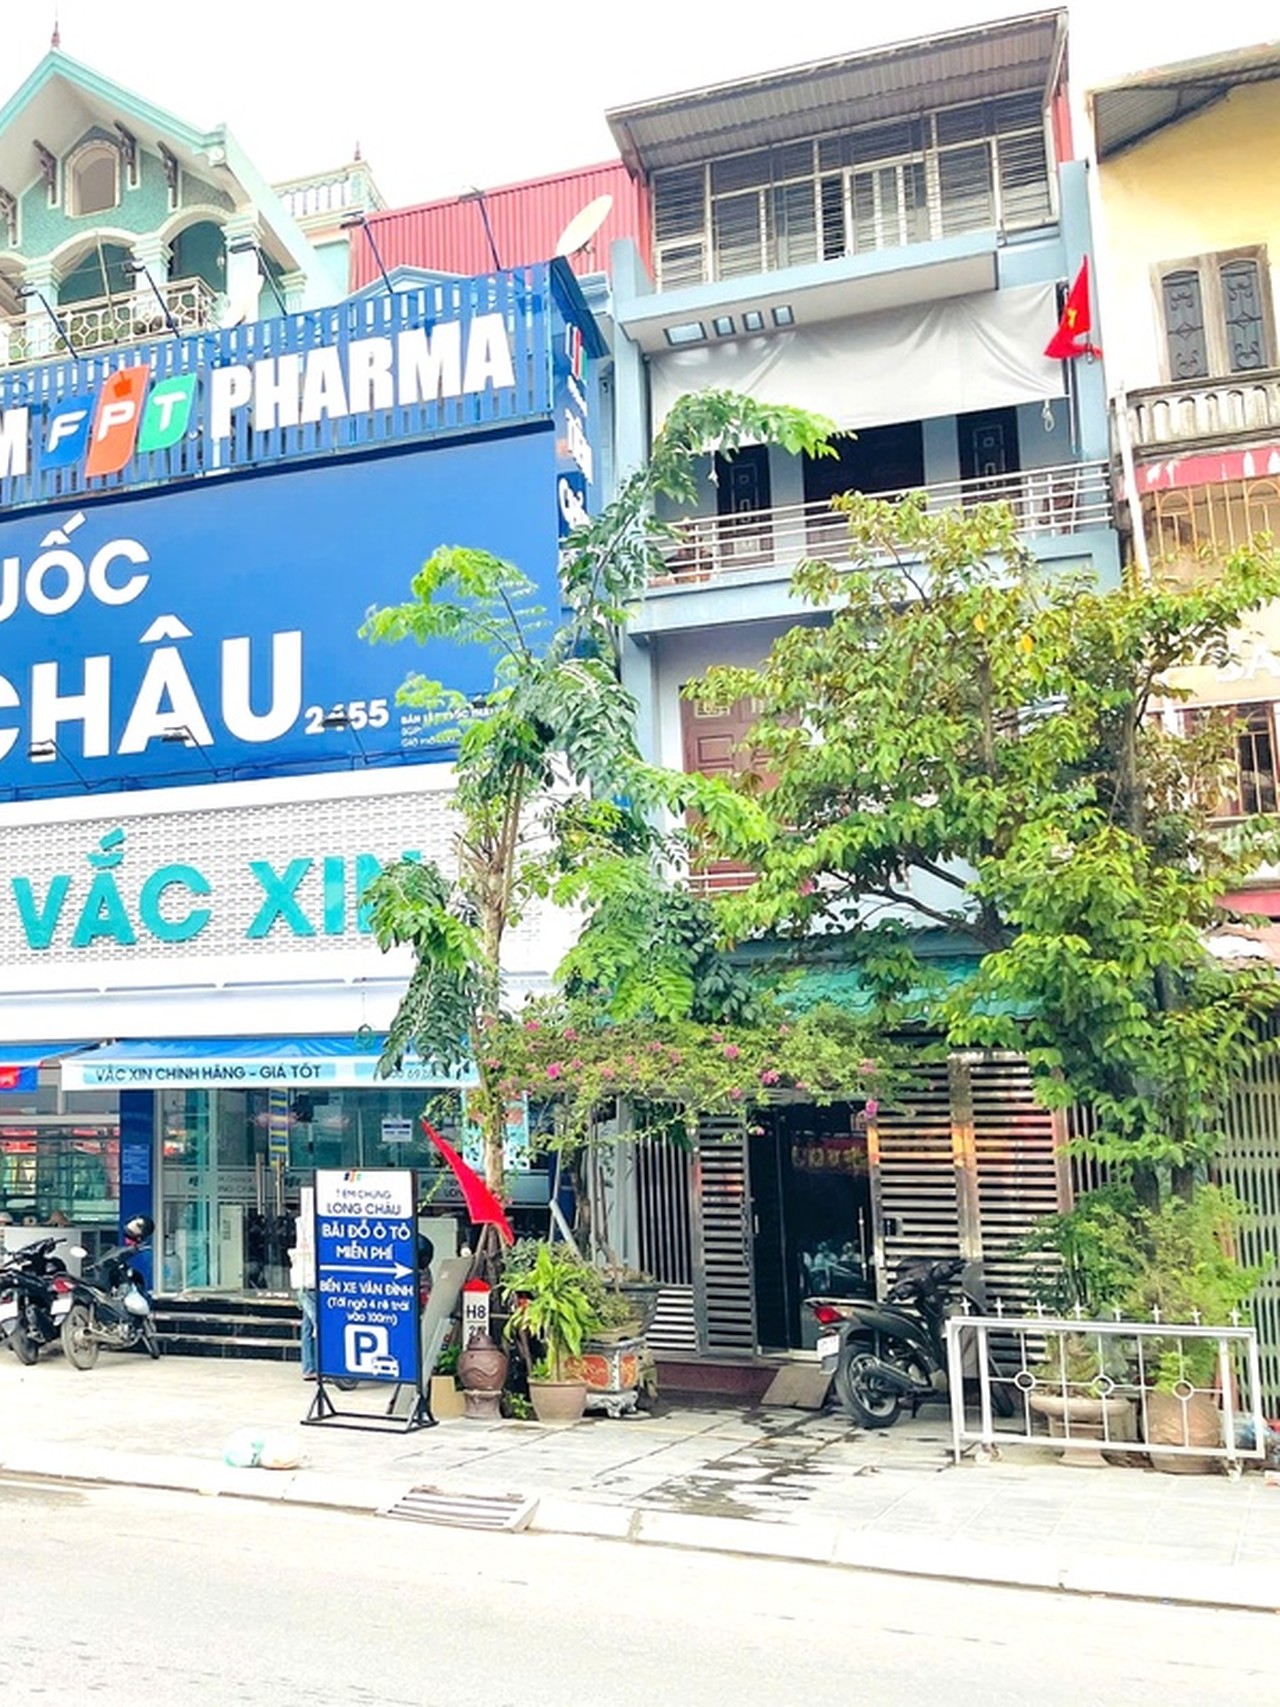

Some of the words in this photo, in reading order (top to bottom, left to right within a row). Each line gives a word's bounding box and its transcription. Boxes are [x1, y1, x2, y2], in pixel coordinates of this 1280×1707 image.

[46, 386, 188, 460] FPT
[211, 312, 517, 440] PHARMA
[12, 827, 214, 949] VẮC
[130, 1067, 153, 1080] XIN
[260, 1062, 286, 1079] GIÁ
[291, 1061, 321, 1079] TỐT
[327, 1203, 362, 1214] LONG
[343, 1281, 358, 1293] XE
[466, 1305, 487, 1319] H8
[354, 1331, 378, 1366] P
